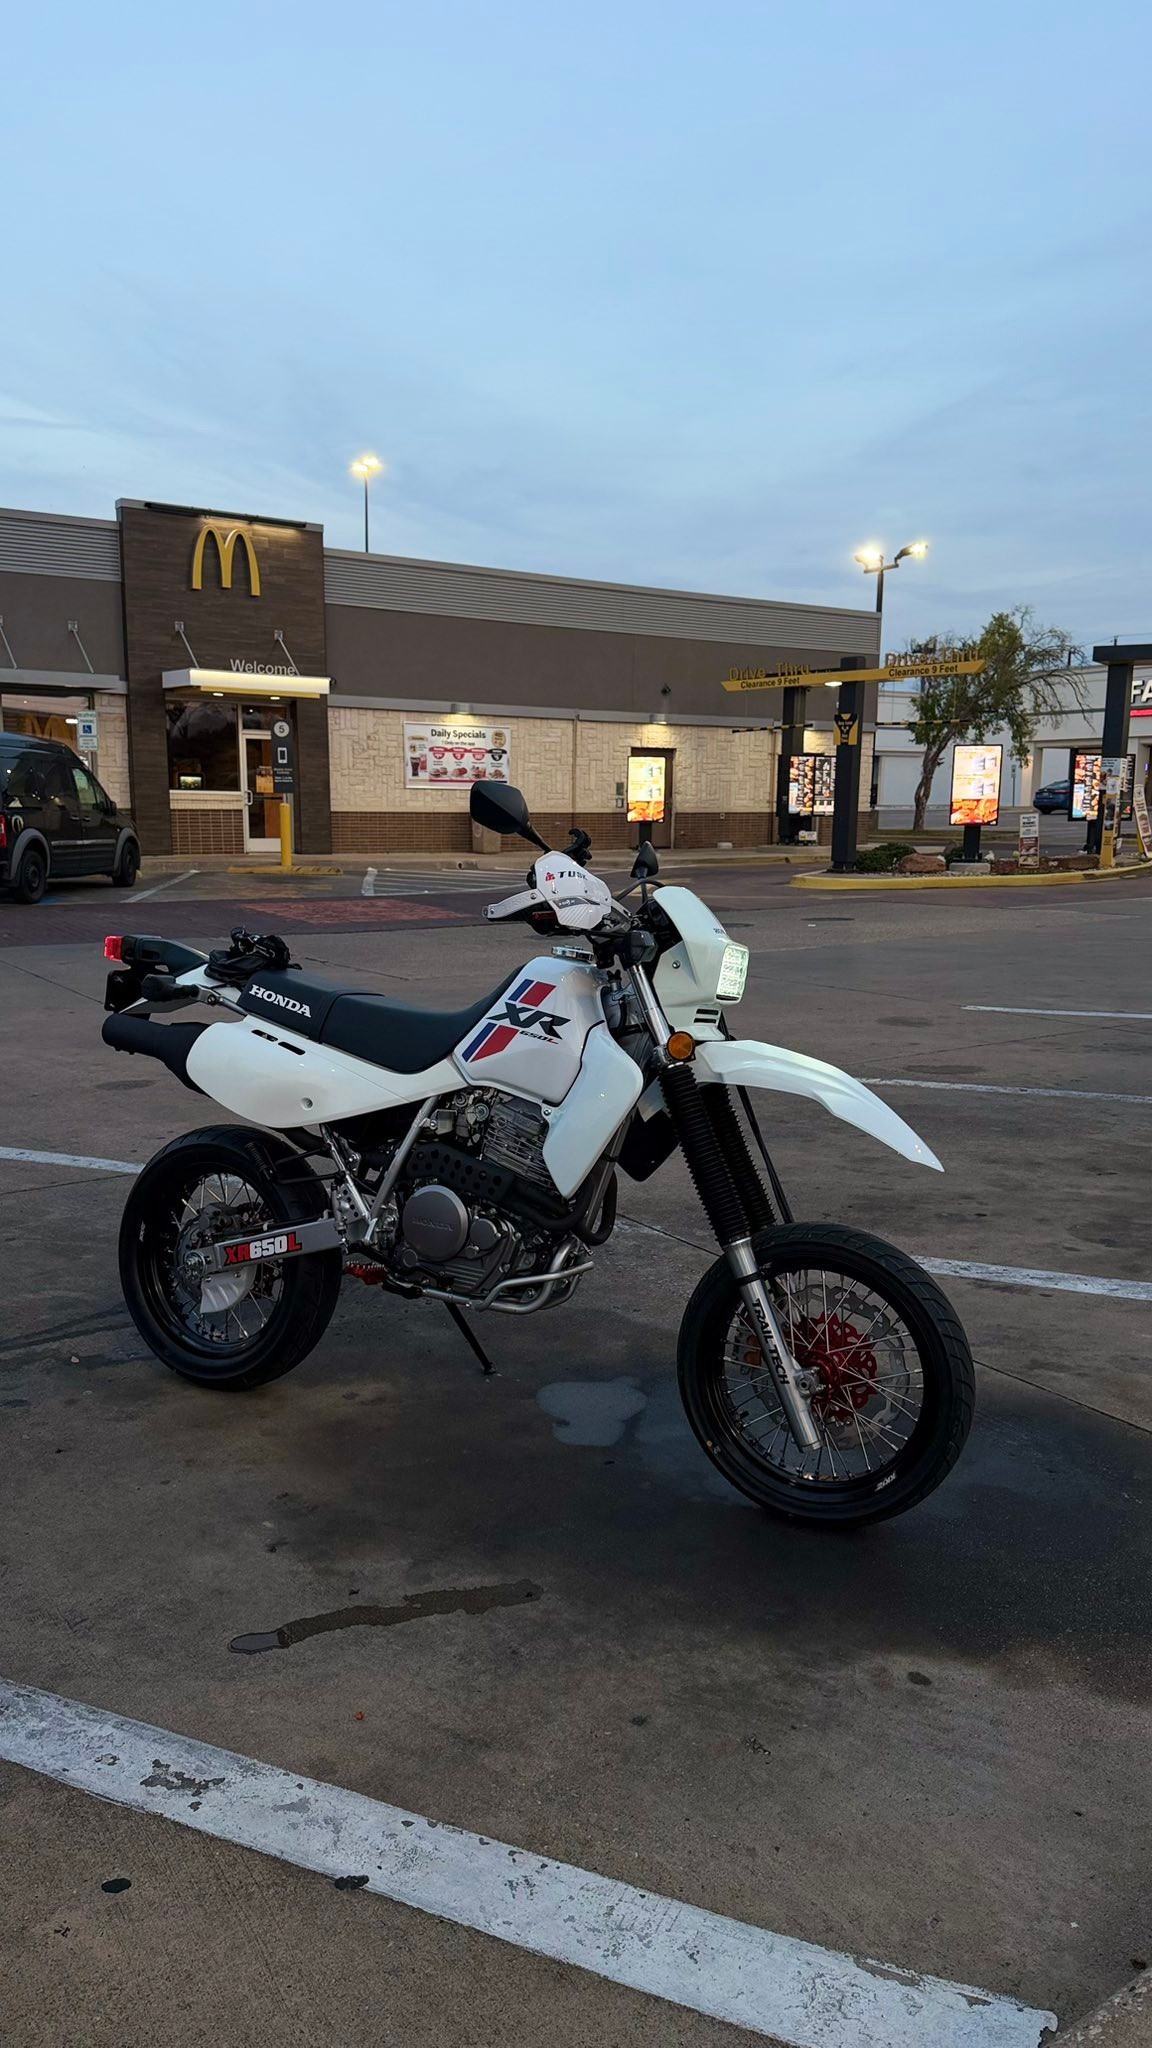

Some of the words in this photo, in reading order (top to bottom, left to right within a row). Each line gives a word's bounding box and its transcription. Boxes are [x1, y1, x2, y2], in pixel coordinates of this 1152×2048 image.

[230, 659, 296, 677] Welcome
[889, 666, 930, 677] Clearance
[931, 665, 938, 674] 9
[940, 664, 958, 674] Feet
[741, 680, 776, 690] Clearance
[777, 678, 783, 686] 9
[783, 676, 800, 685] Feet
[278, 725, 285, 733] 5
[431, 729, 451, 739] Daily
[453, 730, 487, 739] Specials
[249, 984, 312, 1018] HONDA
[486, 1002, 571, 1040] XR
[520, 1030, 559, 1045] 650L
[224, 1232, 302, 1265] XR650L
[769, 1344, 790, 1385] TECH
